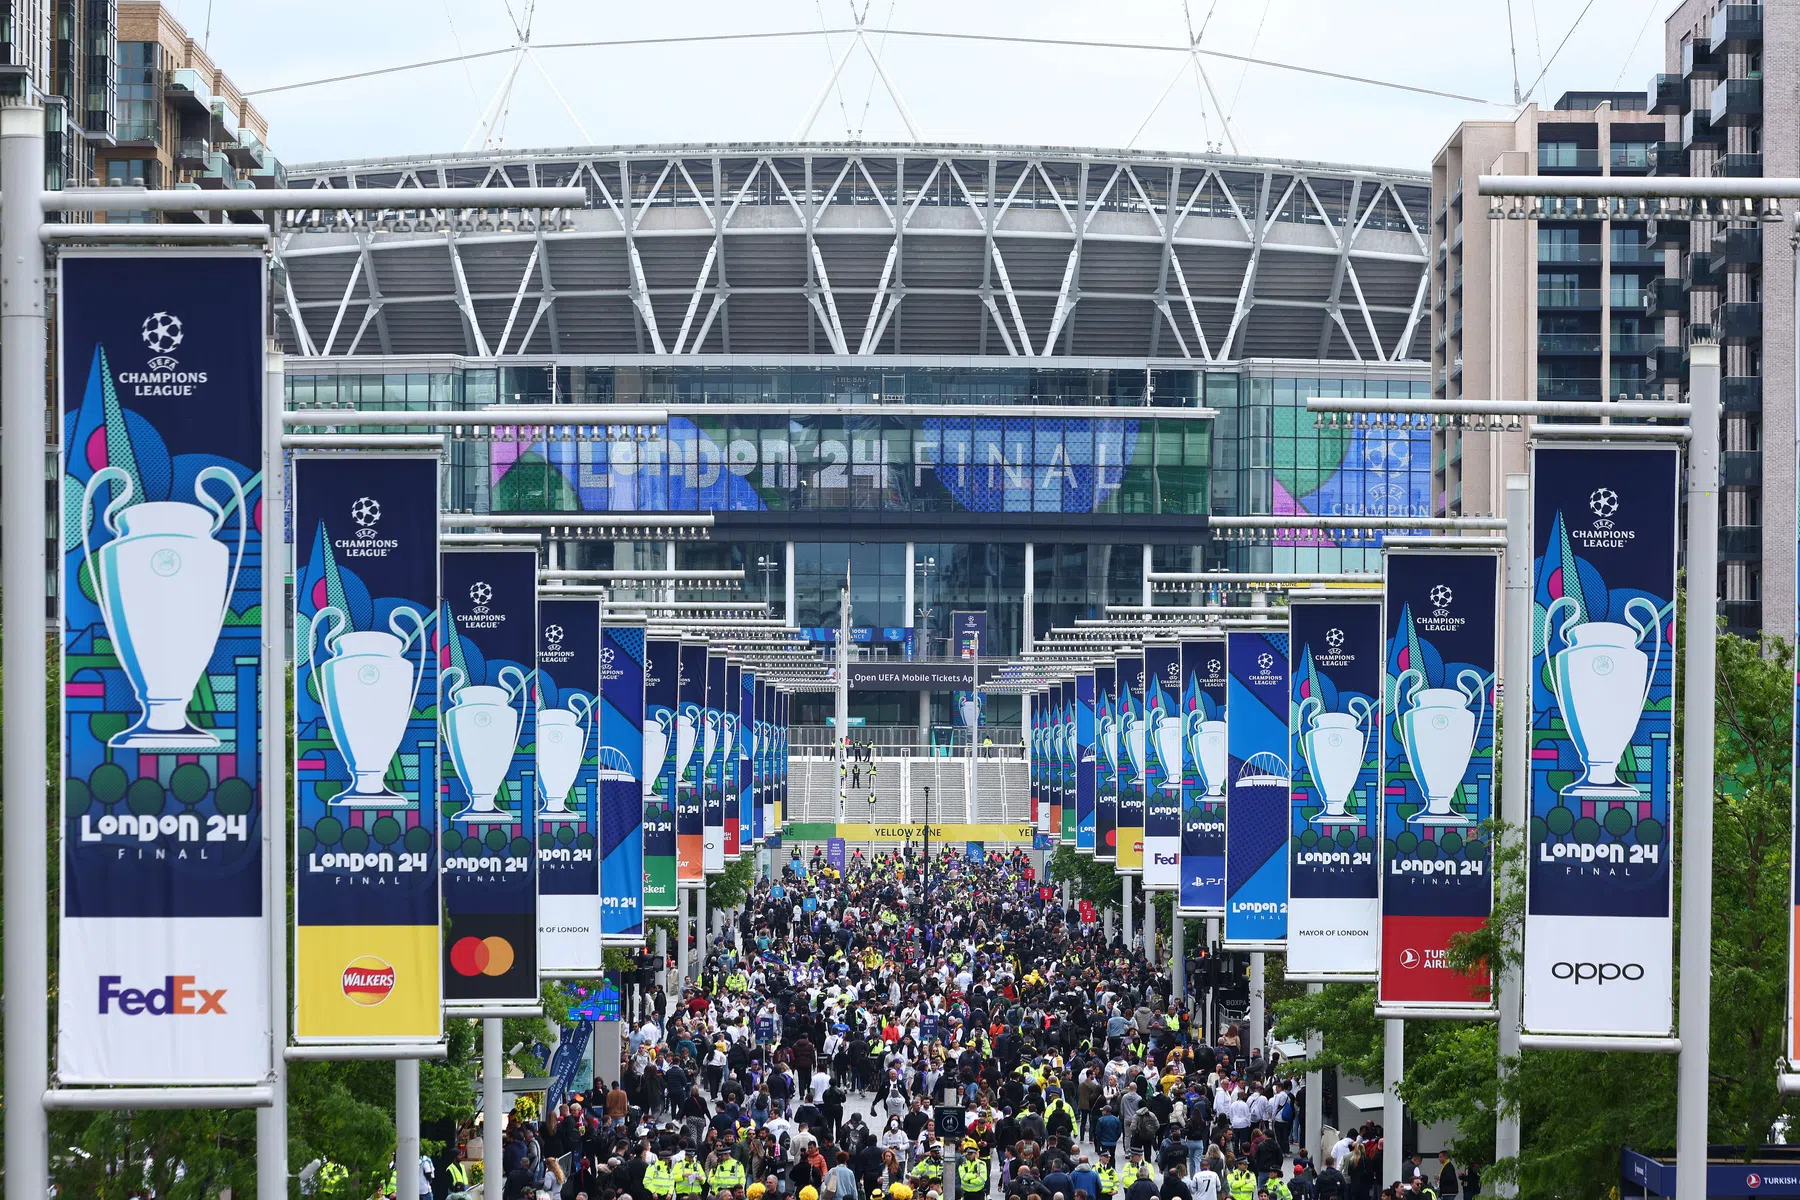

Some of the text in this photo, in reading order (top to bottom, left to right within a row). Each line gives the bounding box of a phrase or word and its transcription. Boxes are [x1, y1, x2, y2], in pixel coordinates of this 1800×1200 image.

[149, 357, 179, 370] UEFA
[119, 372, 207, 384] CHAMPIONS
[135, 385, 192, 396] LEAGUE
[812, 440, 888, 488] 24
[916, 442, 1122, 488] FINAL
[1572, 530, 1635, 538] CHAMPIONS
[335, 540, 398, 548] CHAMPIONS
[346, 549, 388, 557] LEAGUE
[855, 674, 876, 684] Open
[879, 674, 900, 682] UEFA
[902, 674, 930, 682] Mobile
[932, 674, 960, 682] Tickets
[688, 805, 699, 814] 24
[206, 815, 247, 842] 24
[658, 822, 671, 832] 24
[875, 828, 914, 836] YELLOW
[118, 848, 208, 860] FINAL
[573, 849, 592, 862] 24
[1352, 852, 1371, 864] 24
[1630, 844, 1658, 864] 24
[398, 853, 427, 872] 24
[505, 857, 528, 872] 24
[1460, 860, 1482, 876] 24
[1566, 866, 1630, 876] FINAL
[620, 898, 636, 908] 24
[1552, 962, 1644, 985] oppo
[344, 972, 393, 988] WALKERS
[98, 976, 228, 1015] FedEx
[1203, 1179, 1210, 1192] 7
